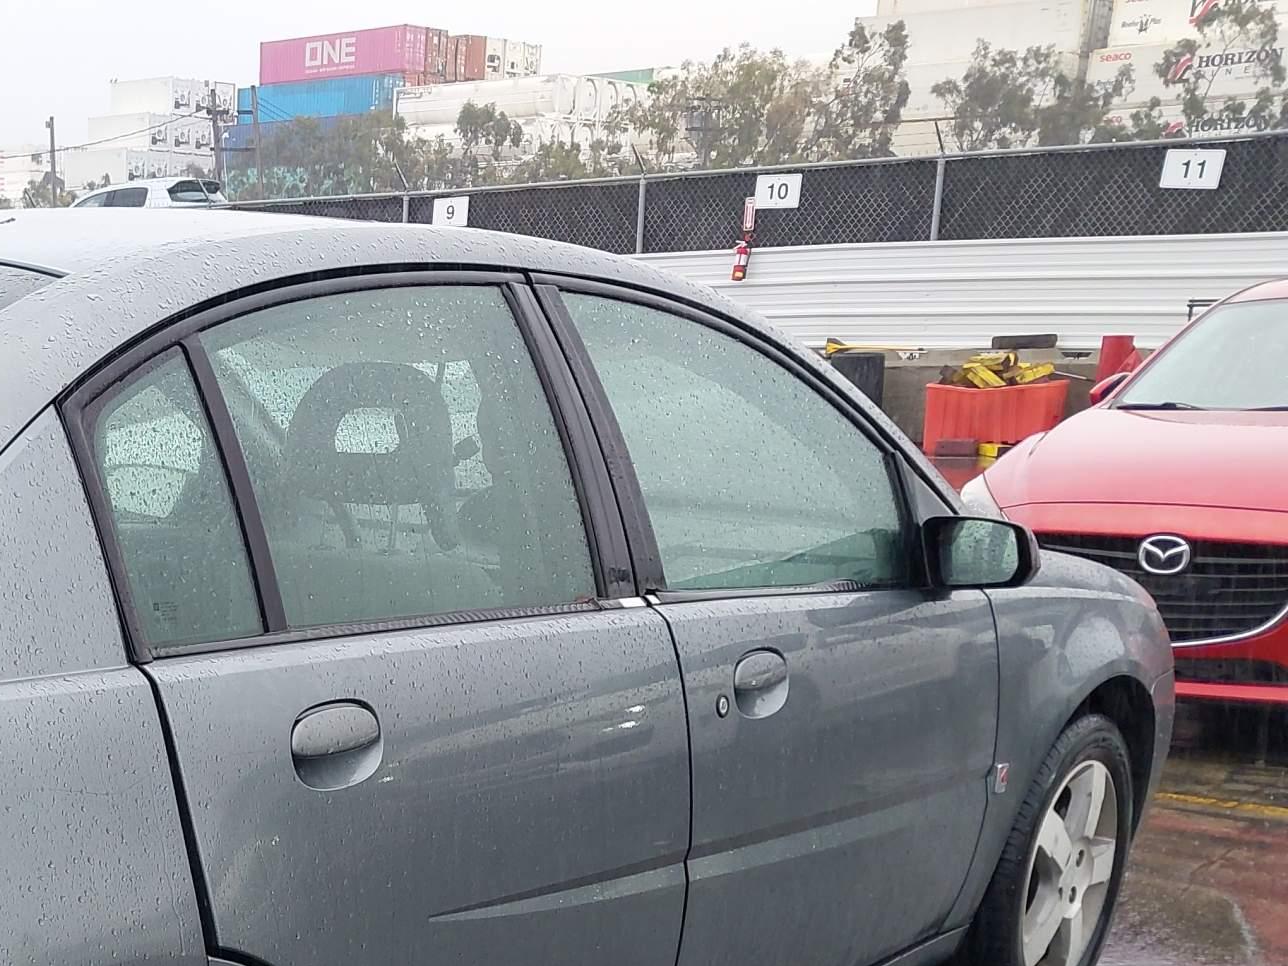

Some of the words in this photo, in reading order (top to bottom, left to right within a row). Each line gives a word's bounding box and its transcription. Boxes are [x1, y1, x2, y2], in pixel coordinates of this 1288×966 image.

[305, 37, 356, 67] ONE
[1100, 52, 1132, 62] seaco
[1198, 48, 1284, 68] HORIZON
[1182, 160, 1206, 179] 11
[768, 183, 789, 200] 10
[446, 204, 455, 220] 9
